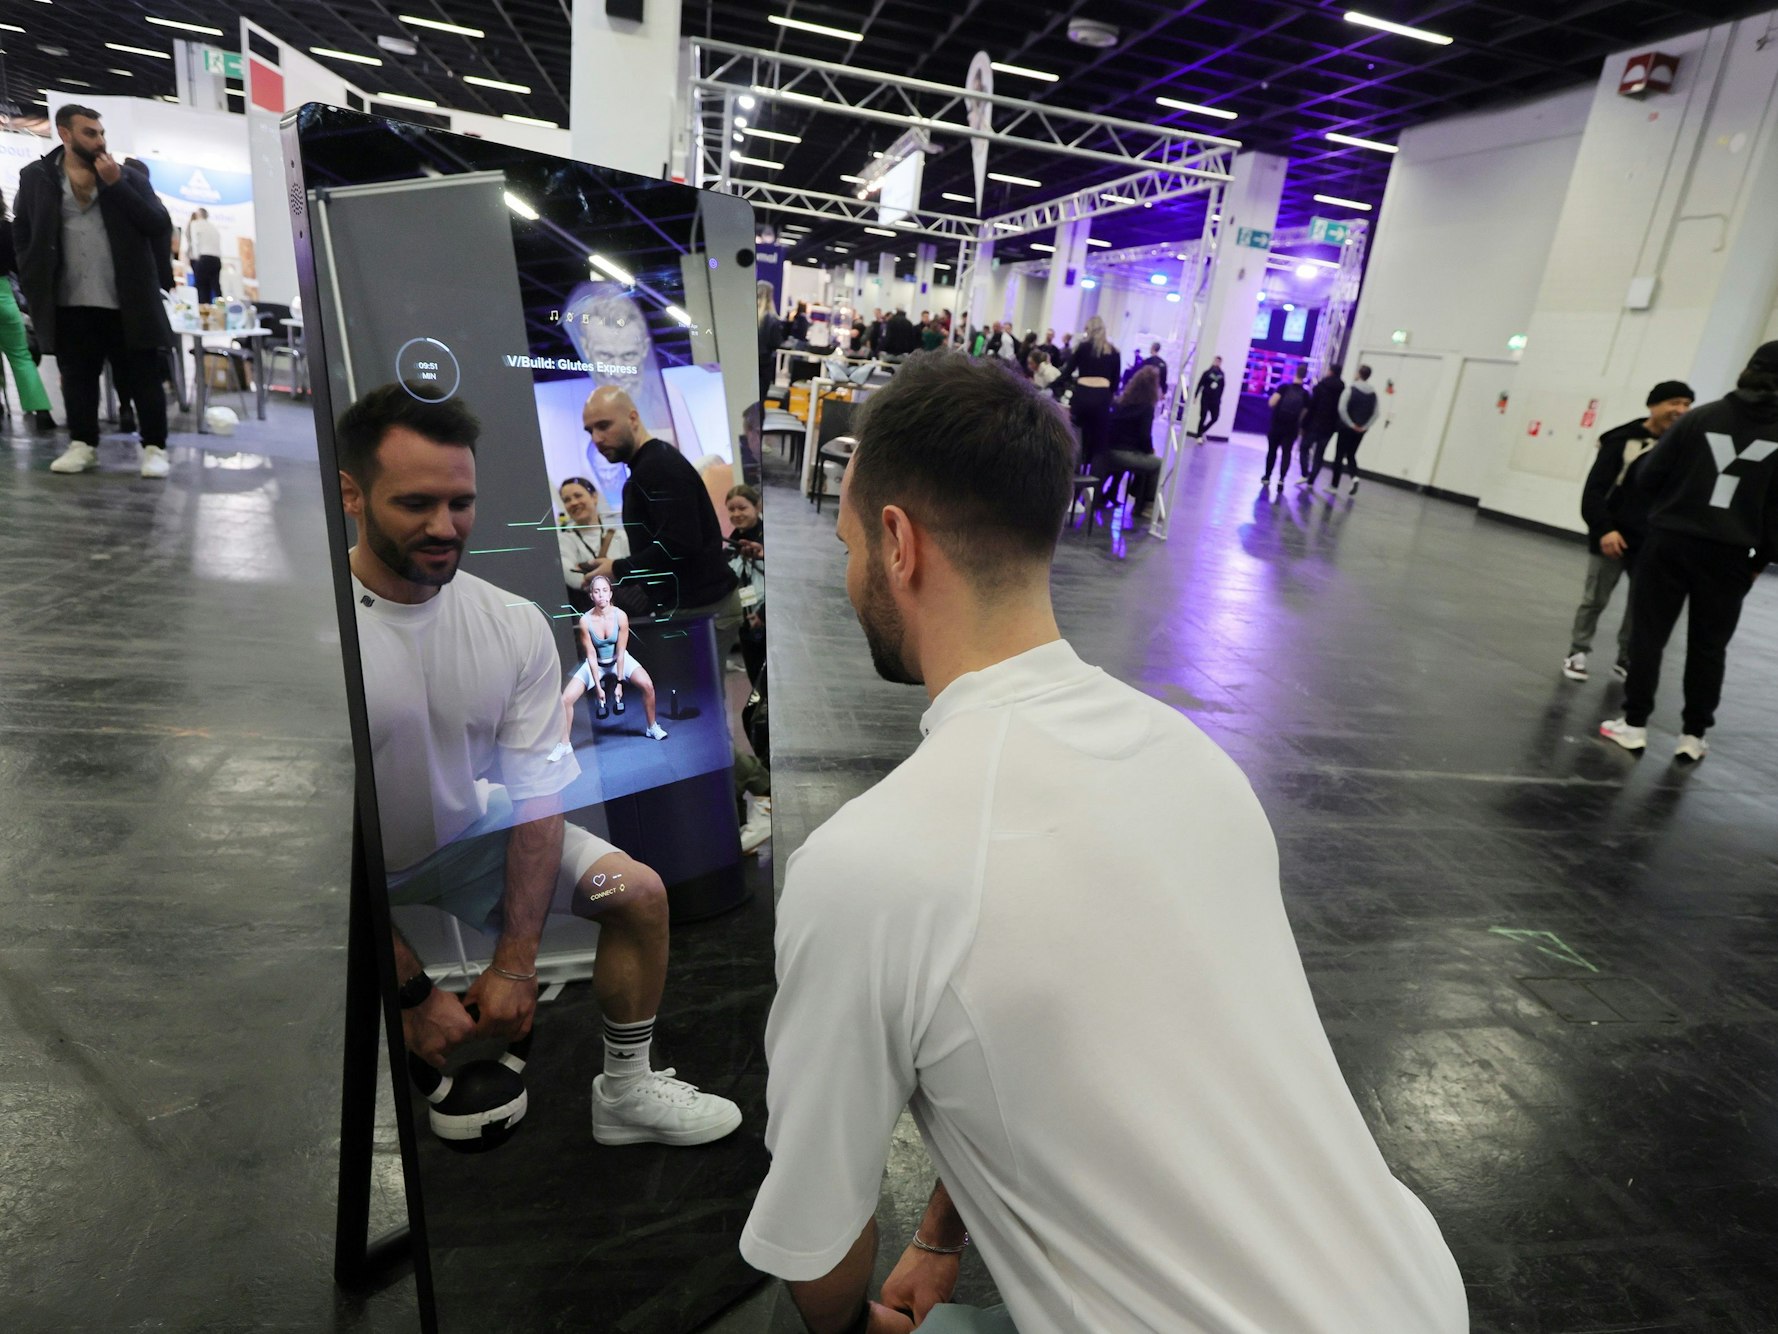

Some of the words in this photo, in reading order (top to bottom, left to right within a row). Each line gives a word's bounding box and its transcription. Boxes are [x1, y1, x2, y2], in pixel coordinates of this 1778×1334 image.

[418, 361, 438, 370] 09:51
[506, 354, 556, 370] V/Build:
[557, 358, 595, 372] Glutes
[596, 361, 638, 376] Express
[422, 372, 437, 380] MIN
[590, 887, 617, 901] CONNECT
